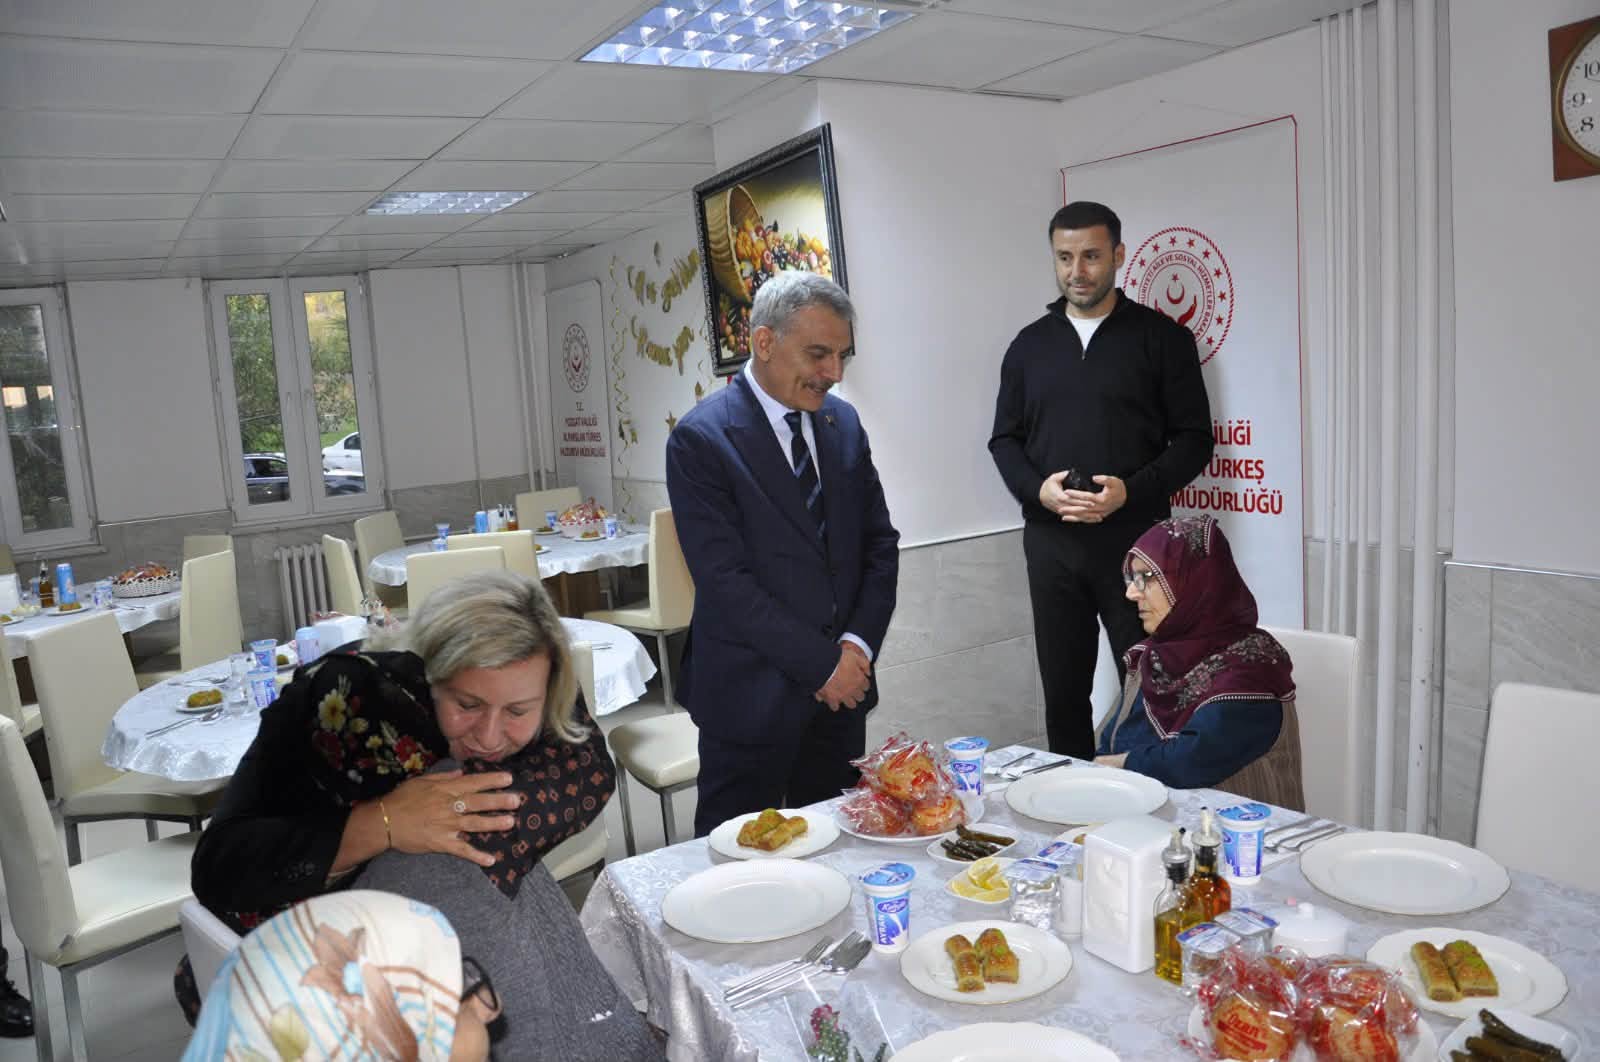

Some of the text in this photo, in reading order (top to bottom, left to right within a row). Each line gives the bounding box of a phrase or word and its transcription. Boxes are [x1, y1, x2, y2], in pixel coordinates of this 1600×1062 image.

[1584, 61, 1600, 79] 10
[1572, 92, 1586, 108] 9
[1580, 116, 1594, 131] 8
[1170, 484, 1283, 515] MÜDÜRLÜĞÜ
